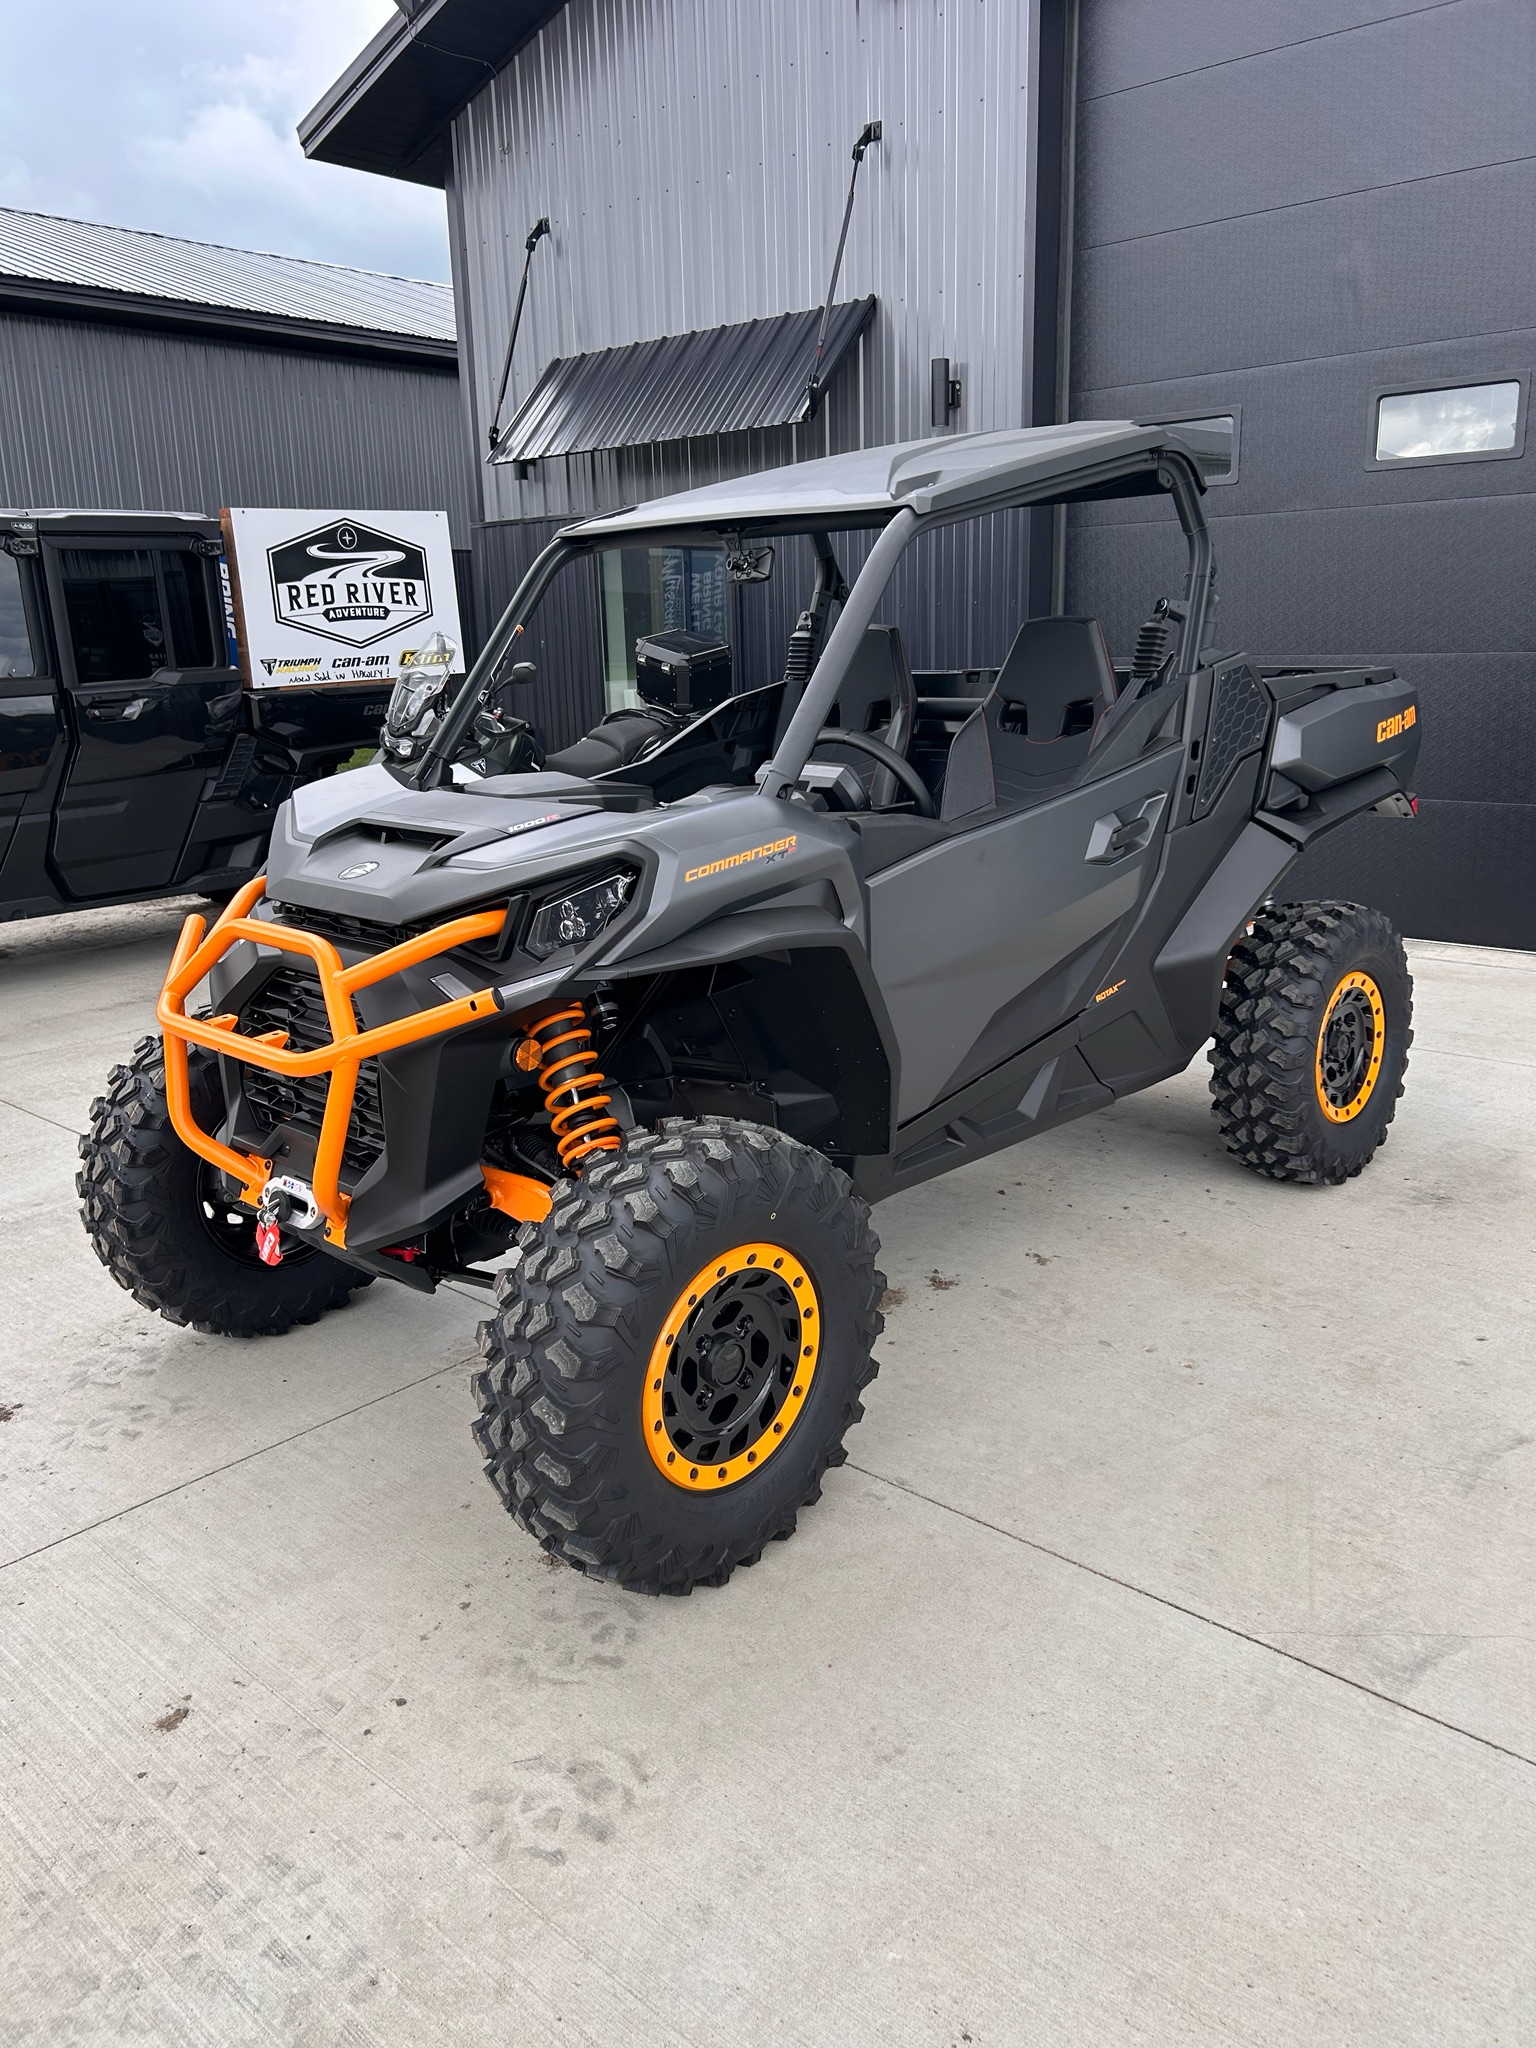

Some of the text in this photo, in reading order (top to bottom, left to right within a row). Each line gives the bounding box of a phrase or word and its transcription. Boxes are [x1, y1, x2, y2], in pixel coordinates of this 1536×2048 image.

[286, 582, 420, 612] RED RIVER
[328, 607, 386, 620] ADVENTURE
[275, 665, 319, 674] RACING
[278, 657, 322, 668] TRIUMPH
[331, 655, 390, 668] can-am
[1376, 704, 1417, 743] can-am
[506, 813, 559, 833] 1000R
[684, 835, 797, 882] COMMANDER
[1095, 983, 1118, 1003] ROTAX
